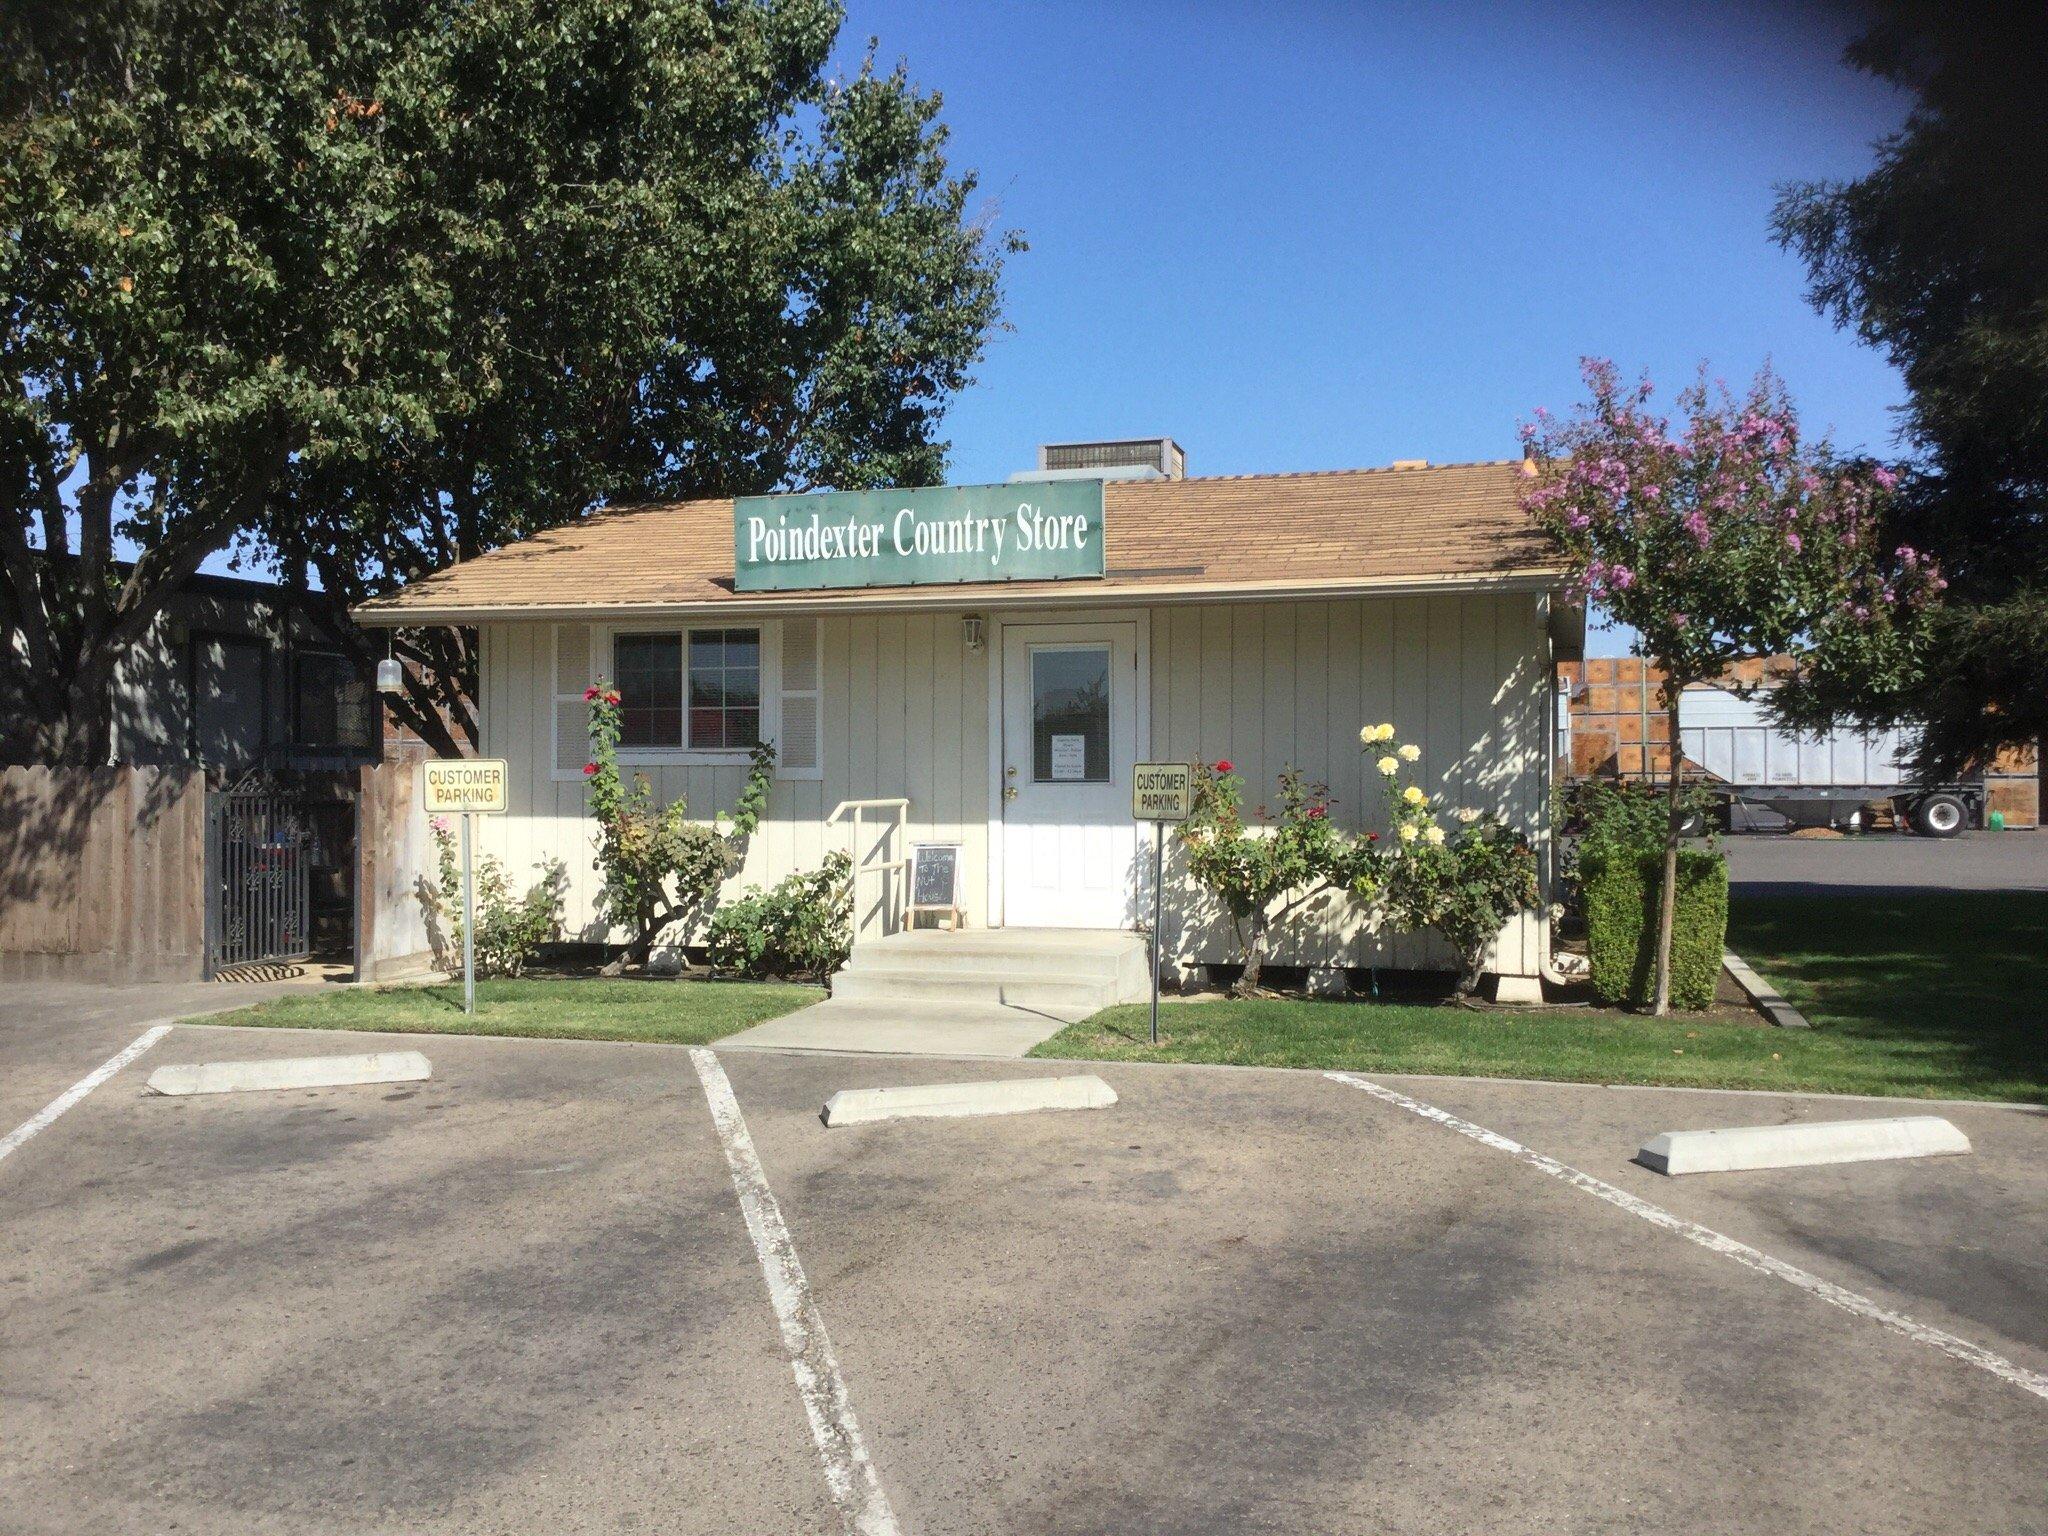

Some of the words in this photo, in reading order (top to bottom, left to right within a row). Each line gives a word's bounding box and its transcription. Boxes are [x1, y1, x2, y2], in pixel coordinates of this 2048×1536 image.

[748, 515, 884, 562] Poindexter
[894, 508, 1007, 566] Country
[1017, 503, 1088, 552] Store
[429, 770, 500, 785] CUSTOMER
[1137, 773, 1186, 790] CUSTOMER
[436, 788, 493, 803] PARKING
[1141, 794, 1180, 811] PARKING
[917, 850, 953, 862] Welcome
